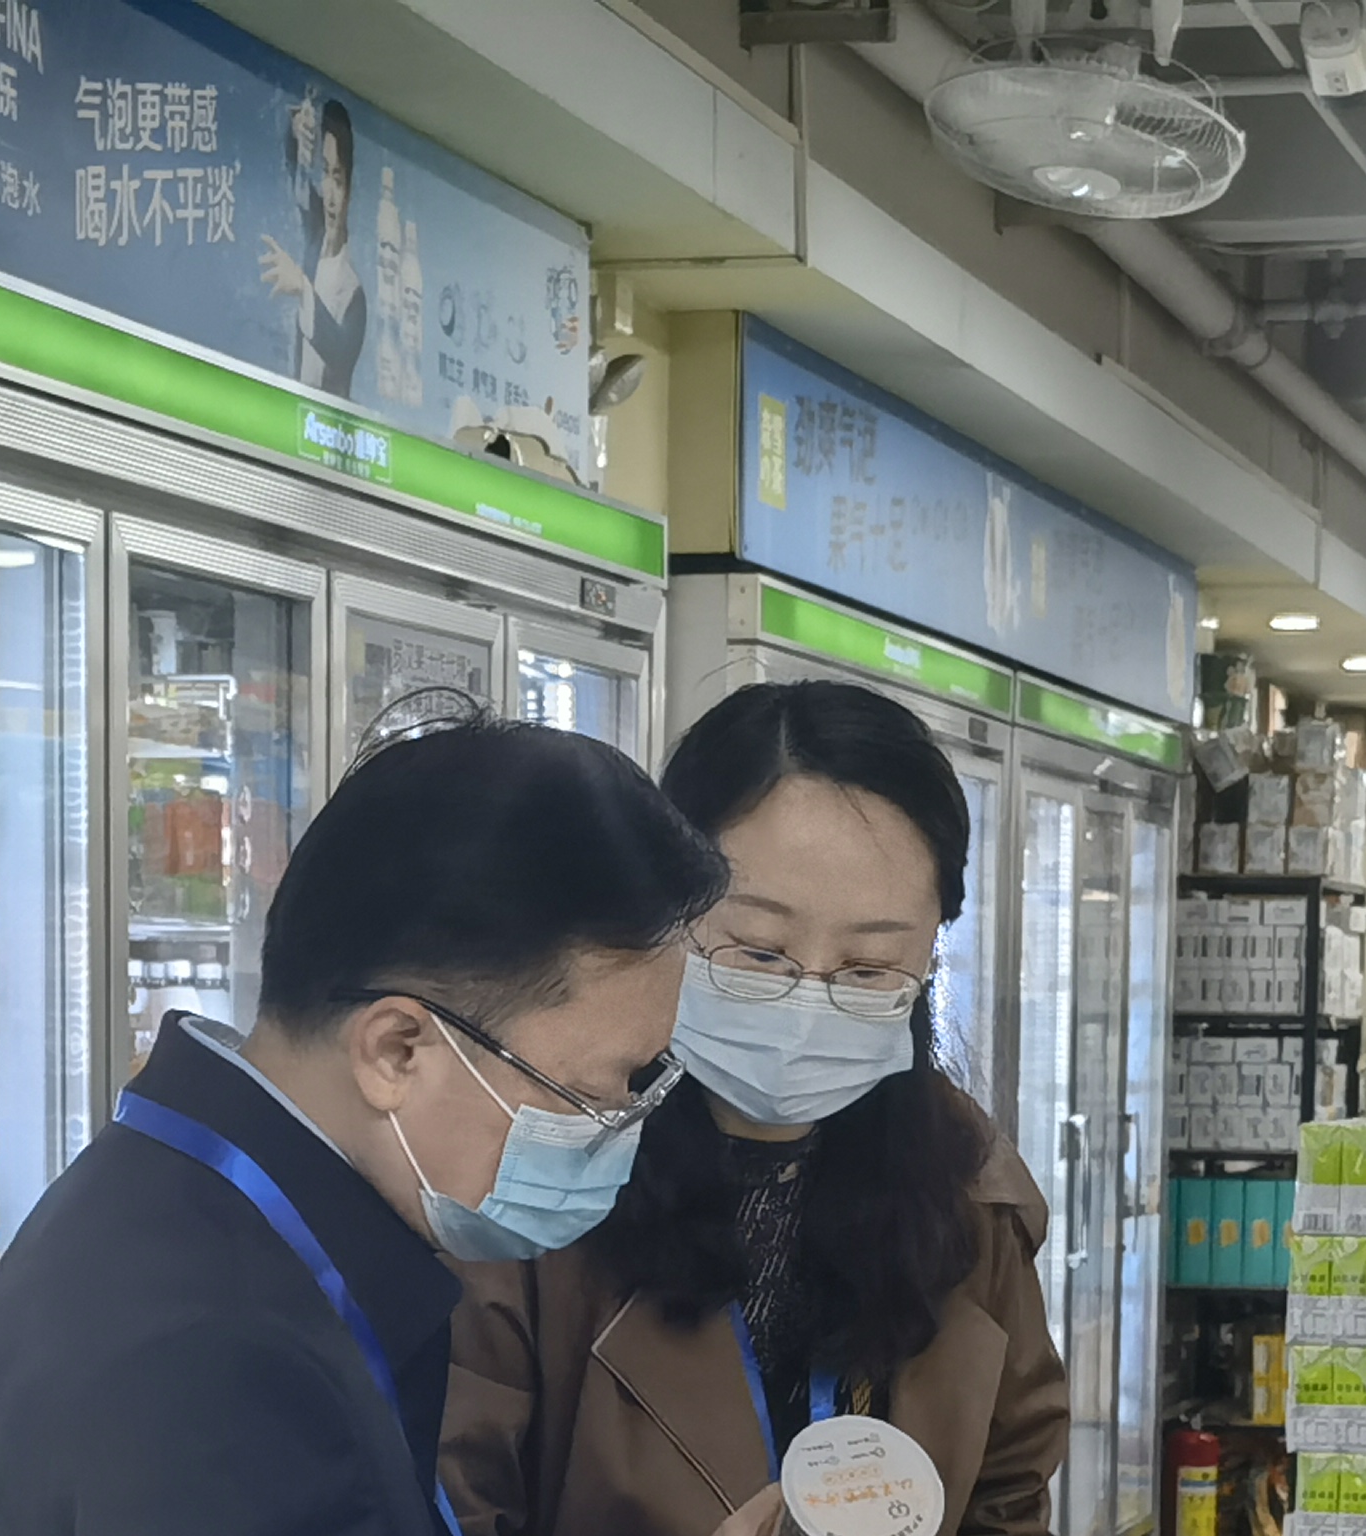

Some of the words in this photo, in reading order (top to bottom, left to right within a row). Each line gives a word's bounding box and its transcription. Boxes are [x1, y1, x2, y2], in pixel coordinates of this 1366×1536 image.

[75, 75, 219, 153] 气泡更带感
[75, 163, 237, 247] 喝水不平淡
